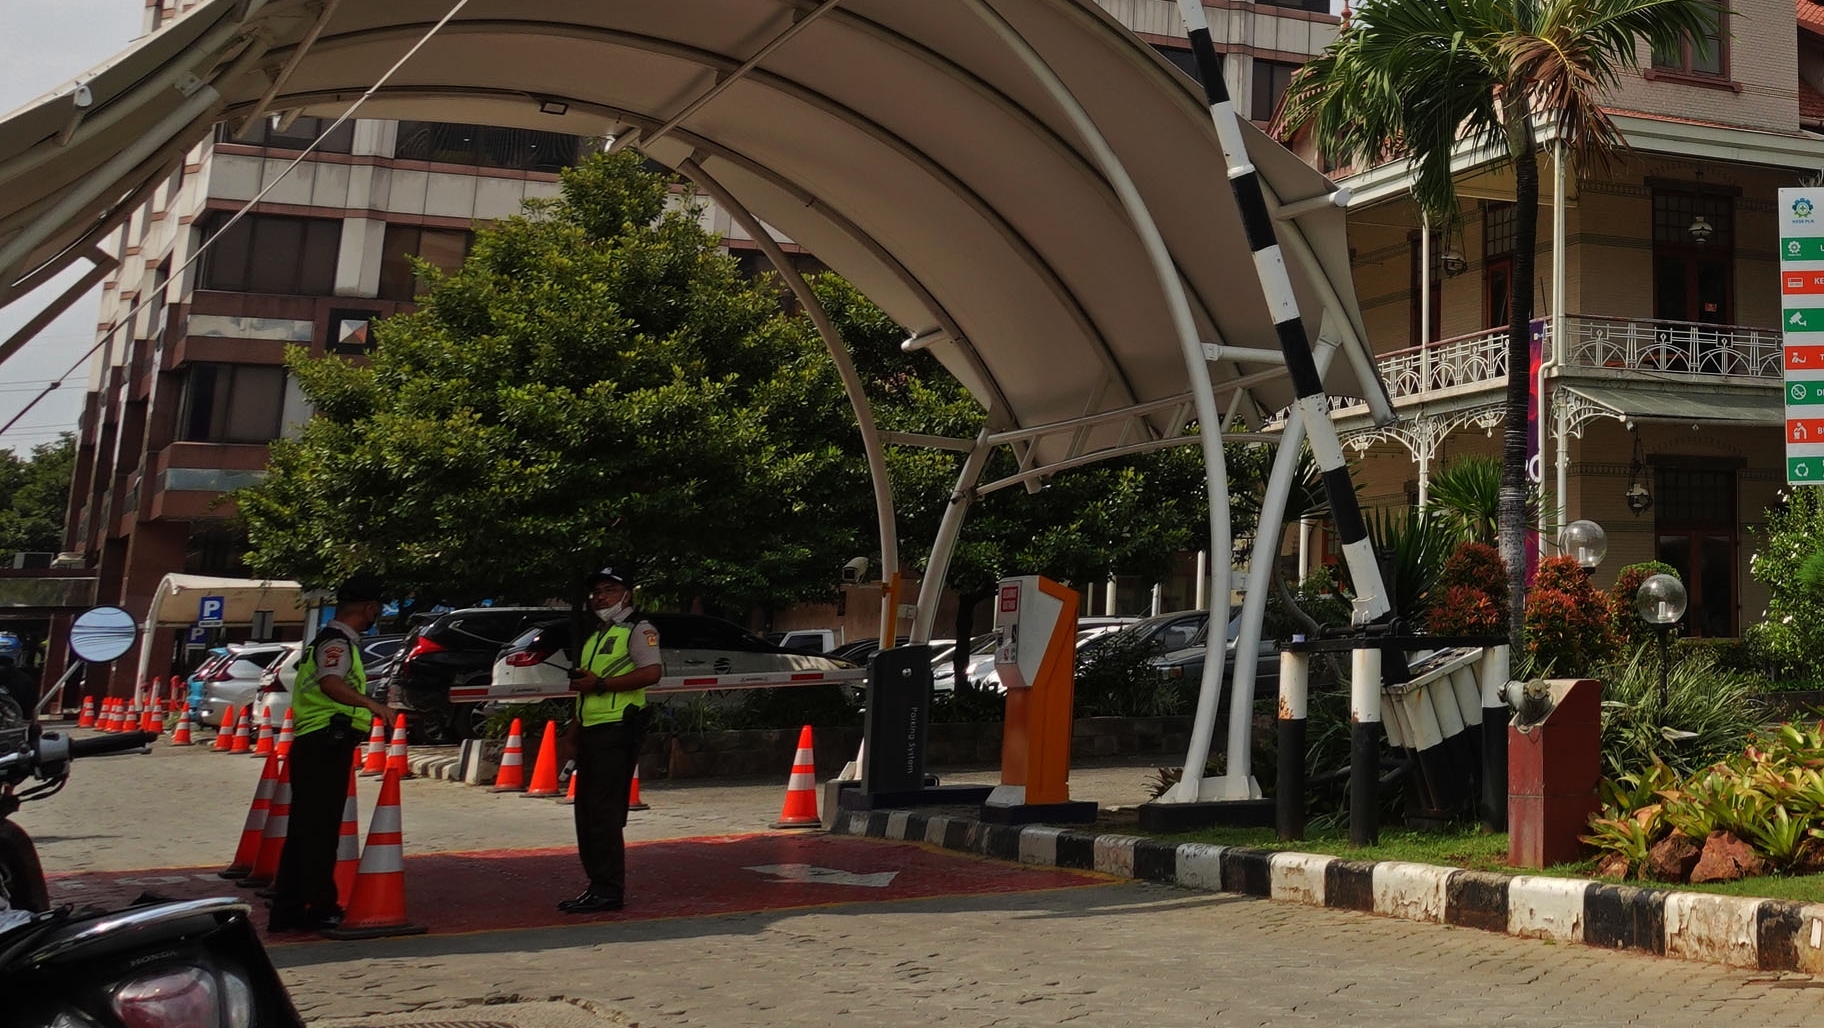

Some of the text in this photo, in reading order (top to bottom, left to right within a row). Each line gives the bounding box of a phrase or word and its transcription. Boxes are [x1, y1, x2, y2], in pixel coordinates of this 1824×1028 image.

[203, 600, 220, 617] P
[190, 627, 204, 641] P
[907, 707, 918, 774] Parking System
